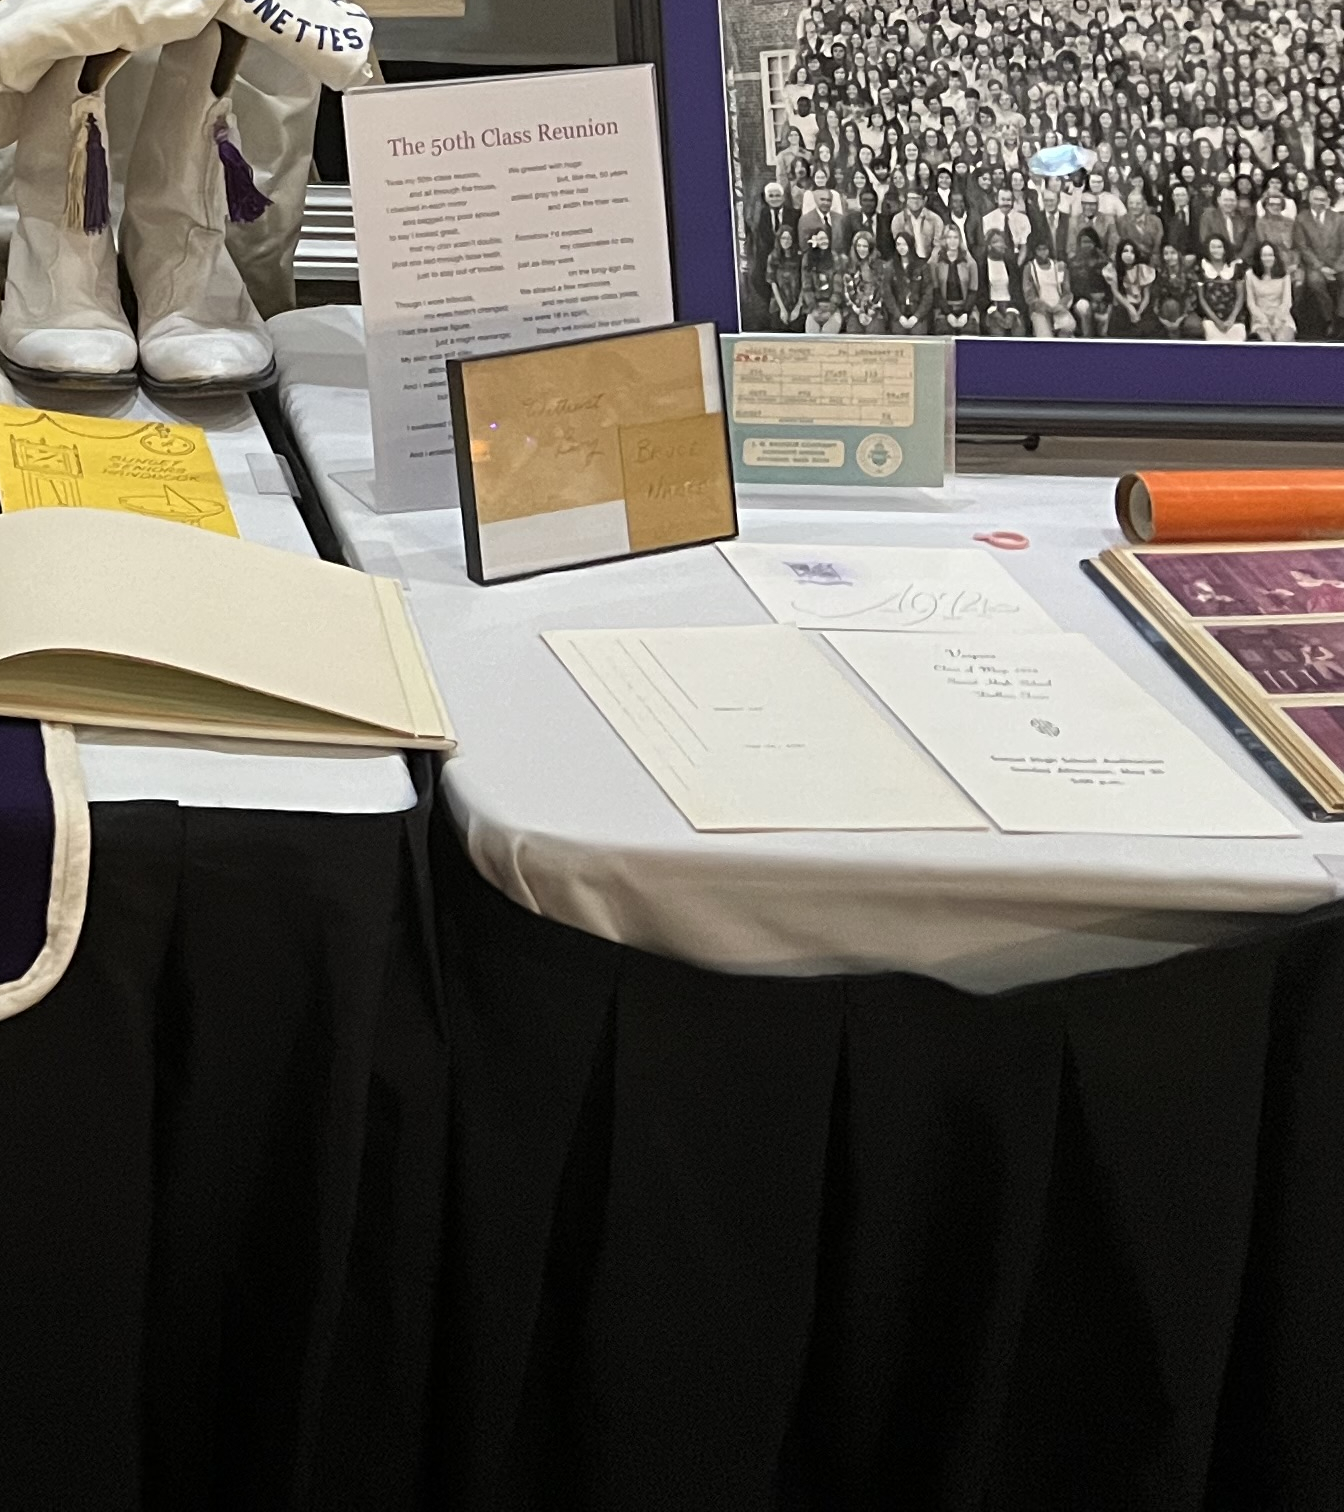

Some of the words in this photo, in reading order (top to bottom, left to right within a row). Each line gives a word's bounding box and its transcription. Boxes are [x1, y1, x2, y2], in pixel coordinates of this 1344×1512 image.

[387, 136, 426, 157] The
[430, 130, 476, 157] 50th
[481, 127, 532, 148] Class
[538, 118, 619, 142] Reunion
